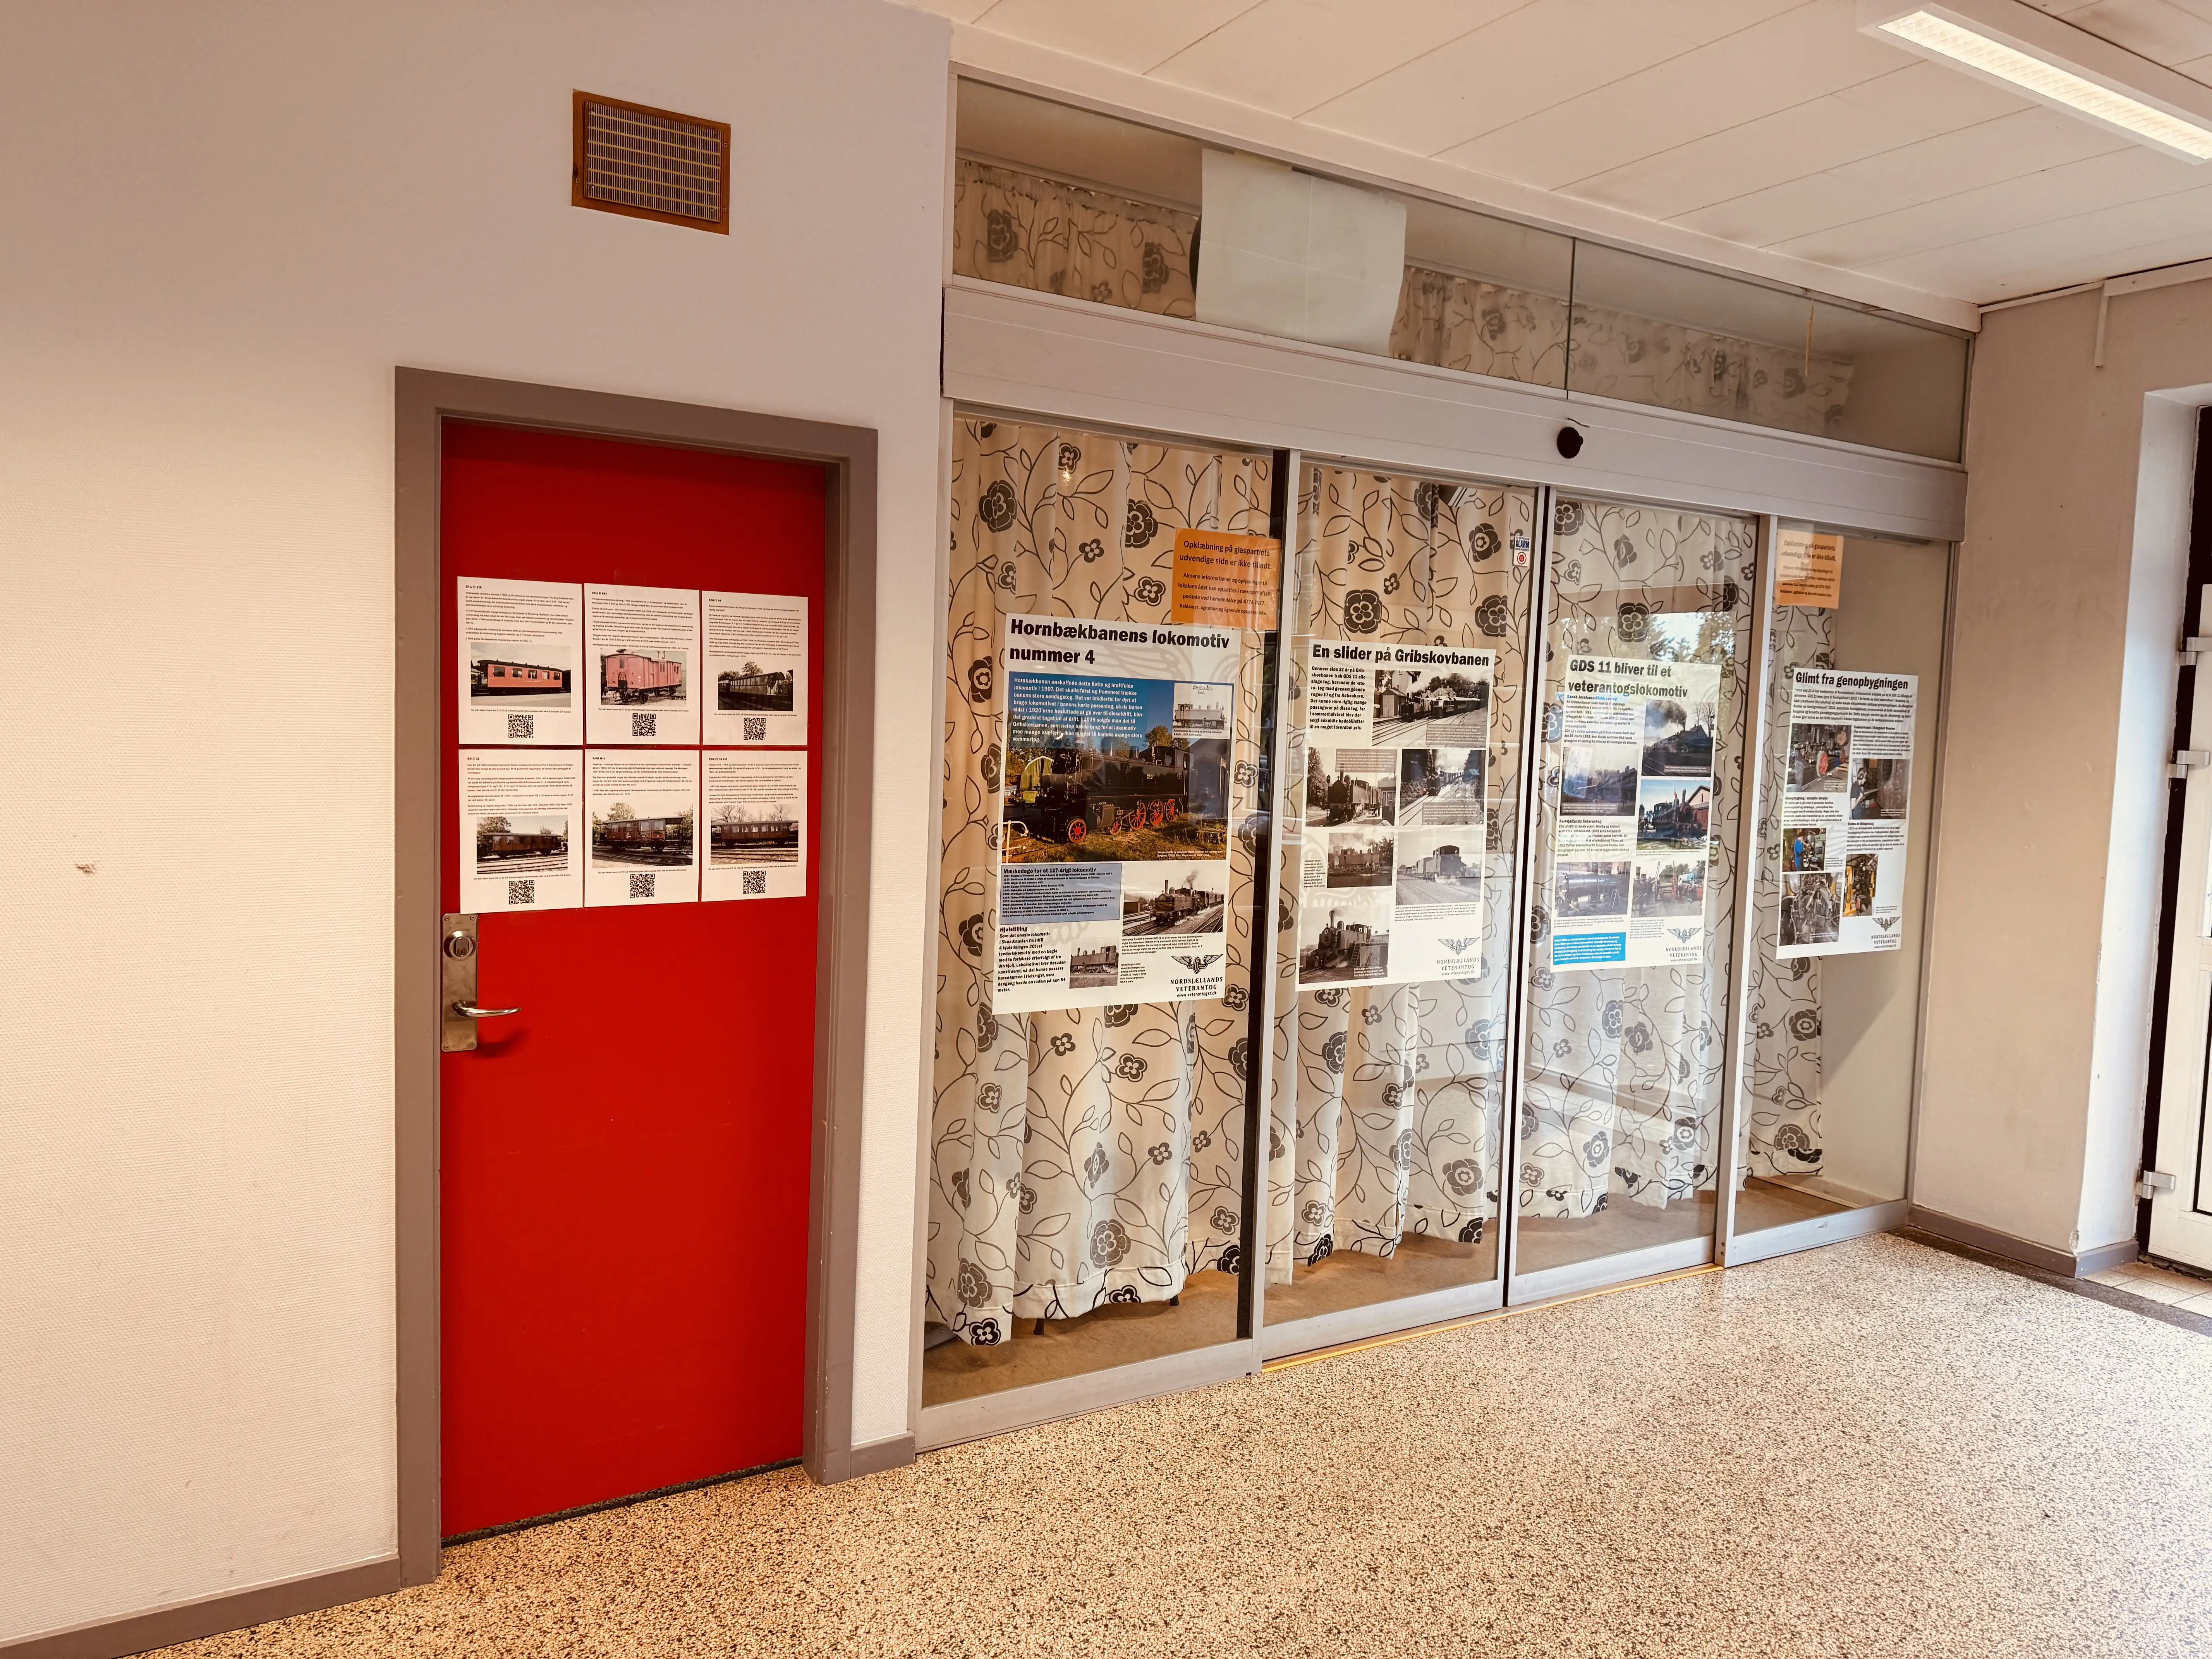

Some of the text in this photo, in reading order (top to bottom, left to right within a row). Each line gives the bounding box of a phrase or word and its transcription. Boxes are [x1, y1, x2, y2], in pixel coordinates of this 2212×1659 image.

[1184, 541, 1223, 552] Opklæbning
[1234, 546, 1269, 556] glaspartiets
[1516, 539, 1529, 548] ALARM
[1180, 554, 1214, 564] udvendige
[1011, 619, 1229, 648] Hornbækbanens lokomotiv
[1010, 648, 1095, 664] nummer 4
[1313, 644, 1488, 666] En slider på Gribskovbanen
[1570, 659, 1671, 677] GDS 11 bliver til et
[1568, 680, 1687, 697] veterantogslokomotiv
[1796, 672, 1908, 690] Glimt fra genopbygningen
